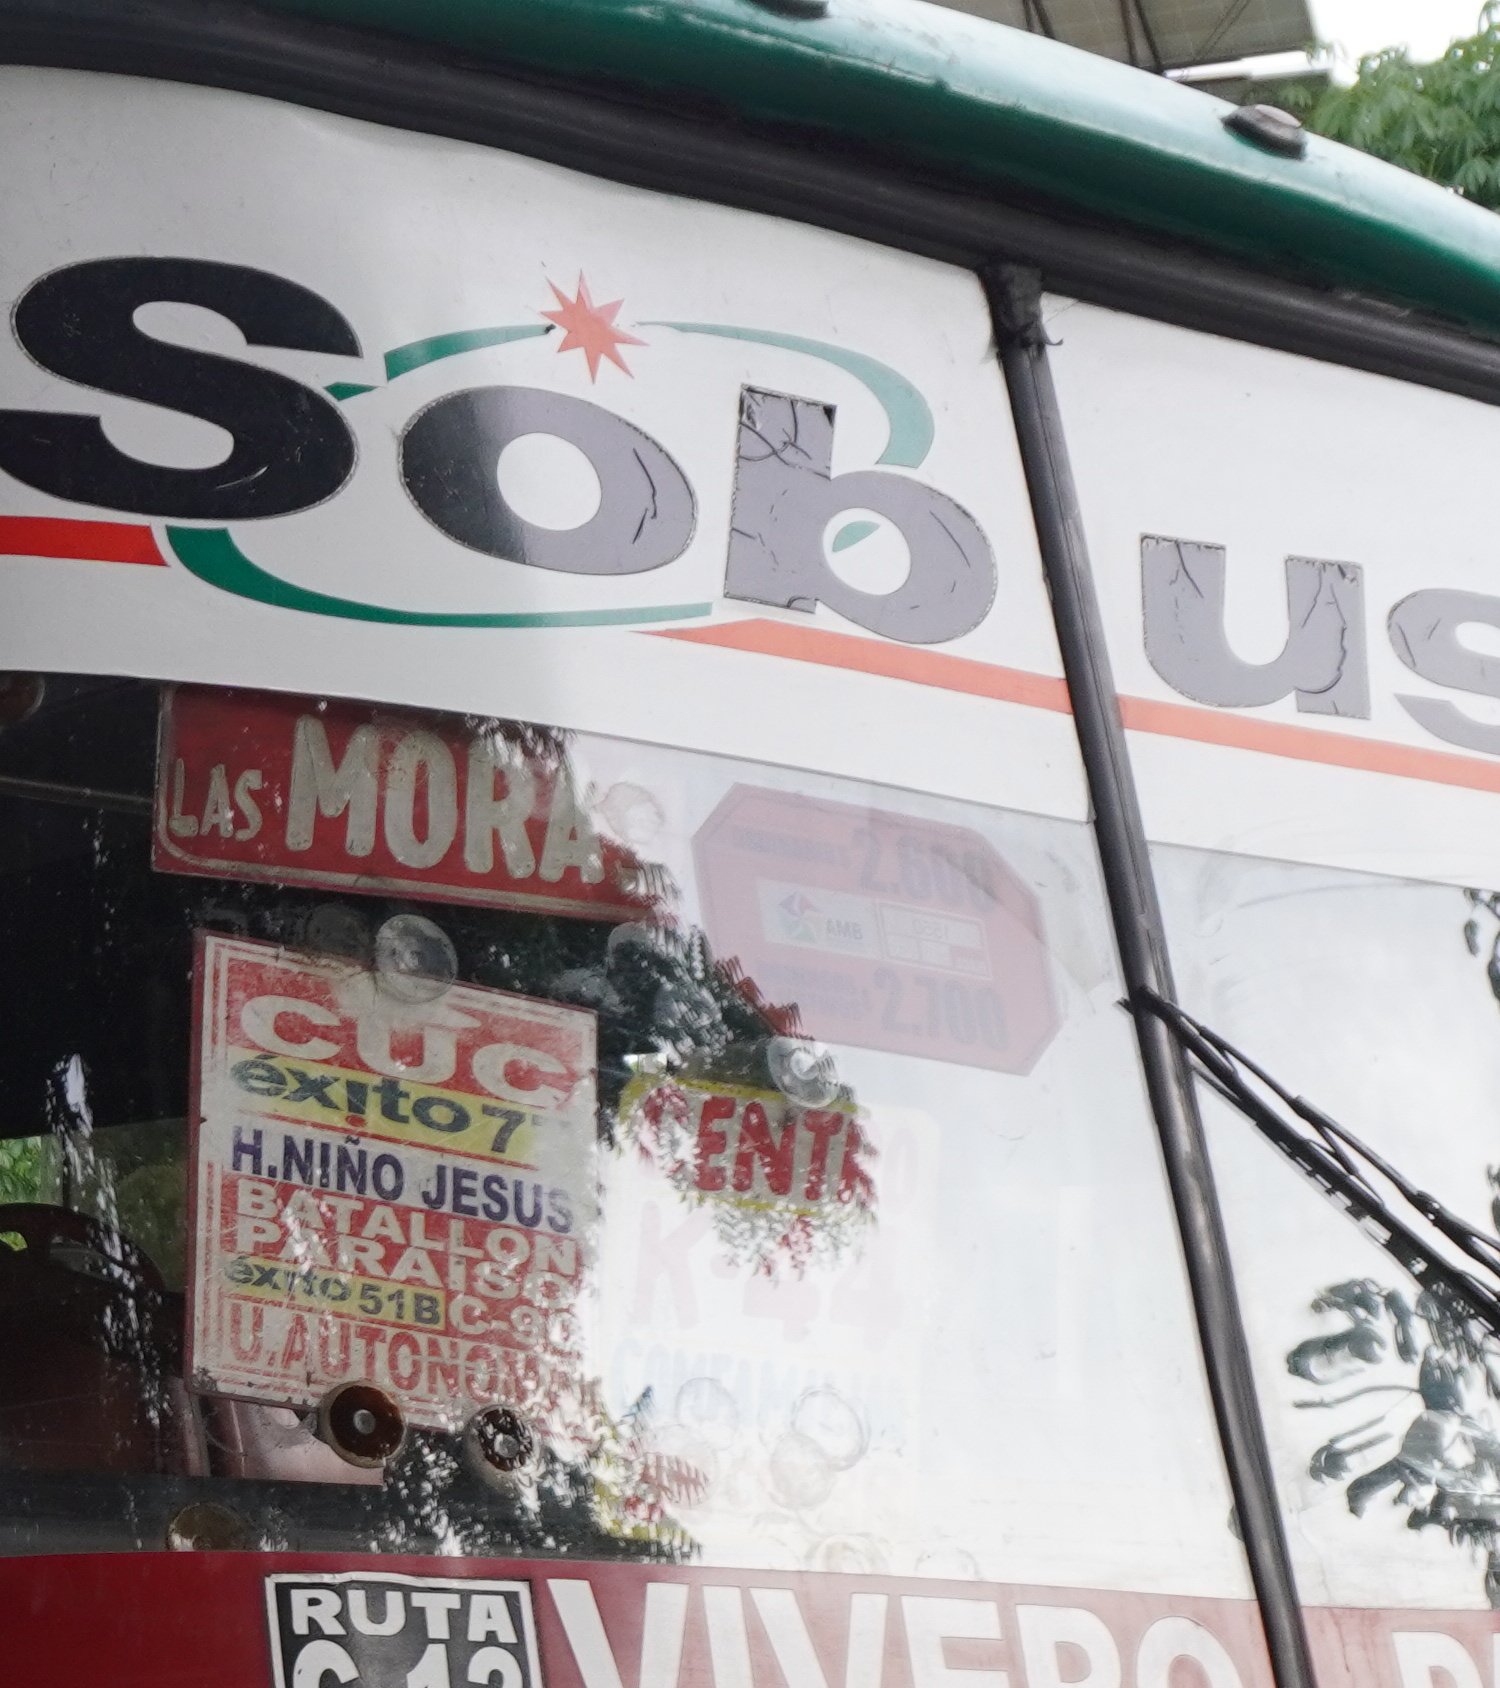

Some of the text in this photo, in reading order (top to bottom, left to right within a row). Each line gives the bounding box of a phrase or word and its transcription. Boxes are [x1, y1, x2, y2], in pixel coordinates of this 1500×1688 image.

[168, 757, 264, 842] LAS
[231, 1054, 472, 1134] éxito
[241, 994, 578, 1108] CUC
[232, 1125, 575, 1234] H.NIÑO JESUS
[236, 1178, 578, 1277] BATALLON
[236, 1216, 577, 1308] PARAISO
[224, 1256, 352, 1302] éxito
[359, 1284, 442, 1327] 51B
[229, 1302, 565, 1403] U.AUTONOM
[289, 1588, 520, 1644] RUTA
